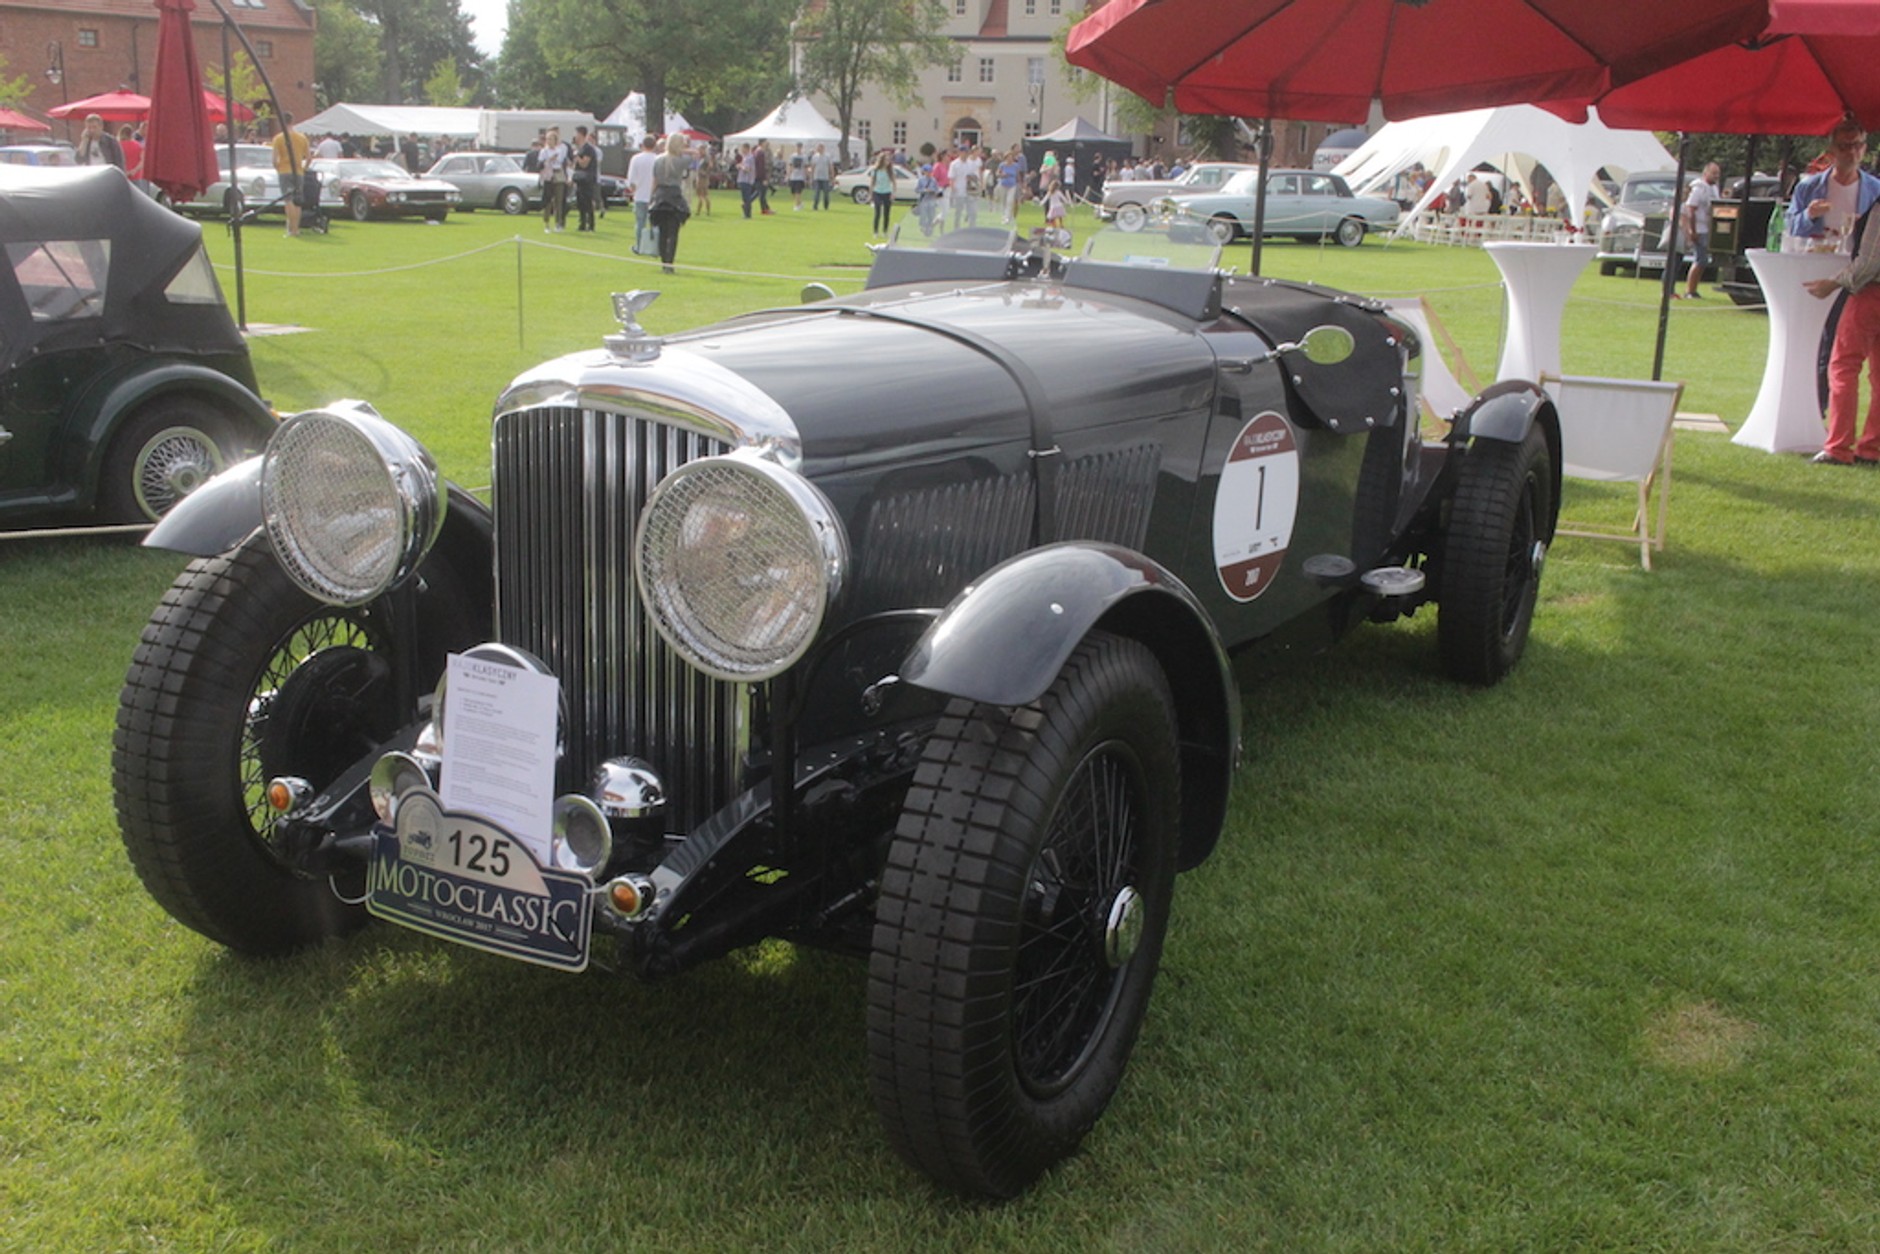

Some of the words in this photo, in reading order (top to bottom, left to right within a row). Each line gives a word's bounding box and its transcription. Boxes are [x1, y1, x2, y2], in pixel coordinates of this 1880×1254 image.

[1256, 466, 1266, 531] 1
[449, 830, 510, 876] 125
[377, 854, 577, 941] MOTOCLASSIC
